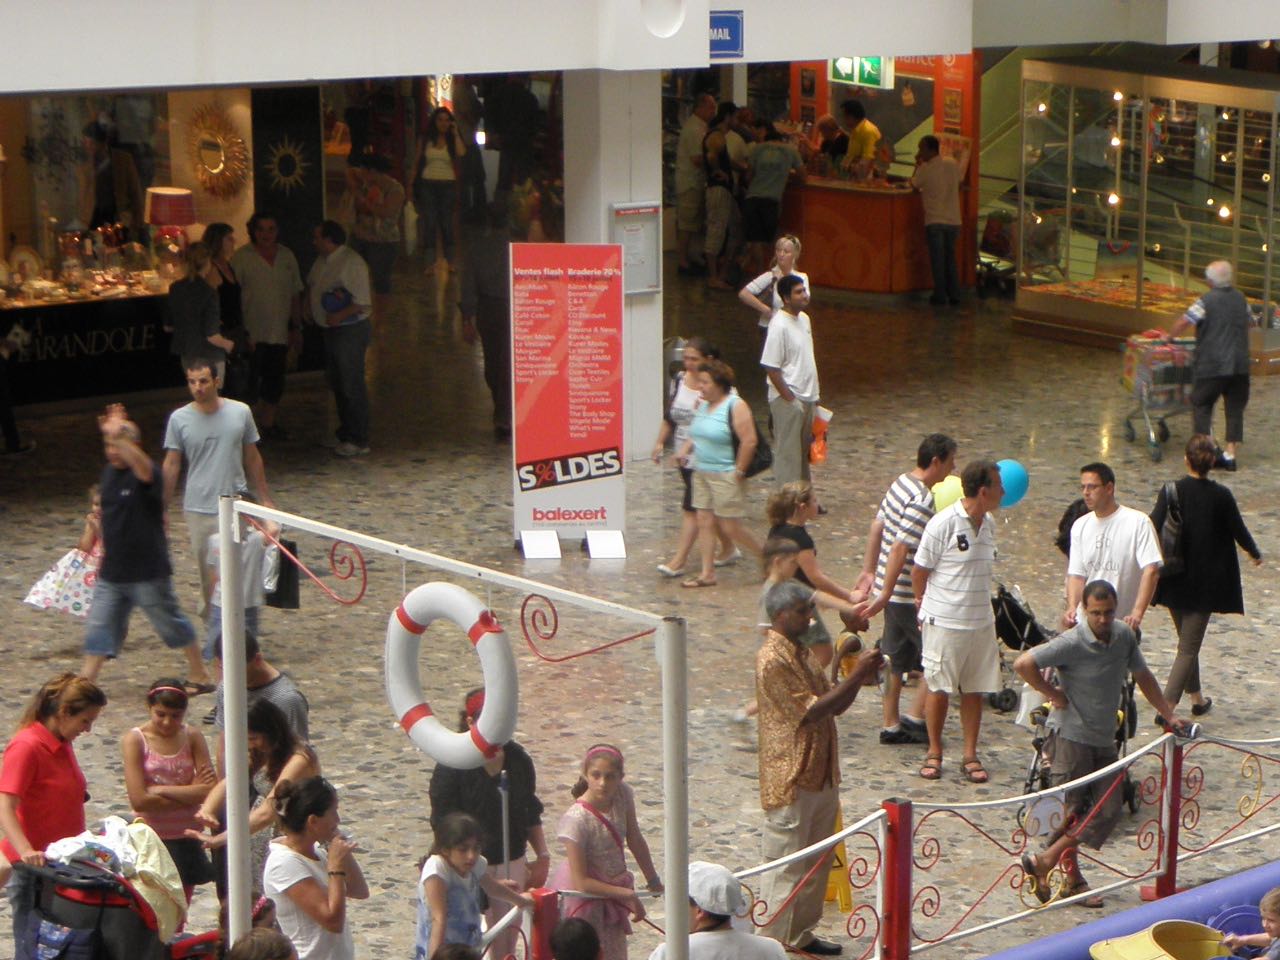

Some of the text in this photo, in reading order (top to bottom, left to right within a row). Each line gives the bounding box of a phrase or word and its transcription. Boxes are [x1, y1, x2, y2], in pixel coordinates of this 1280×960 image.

[514, 267, 564, 276] Ventes flash
[567, 267, 602, 276] Braderie
[532, 506, 607, 521] balexert
